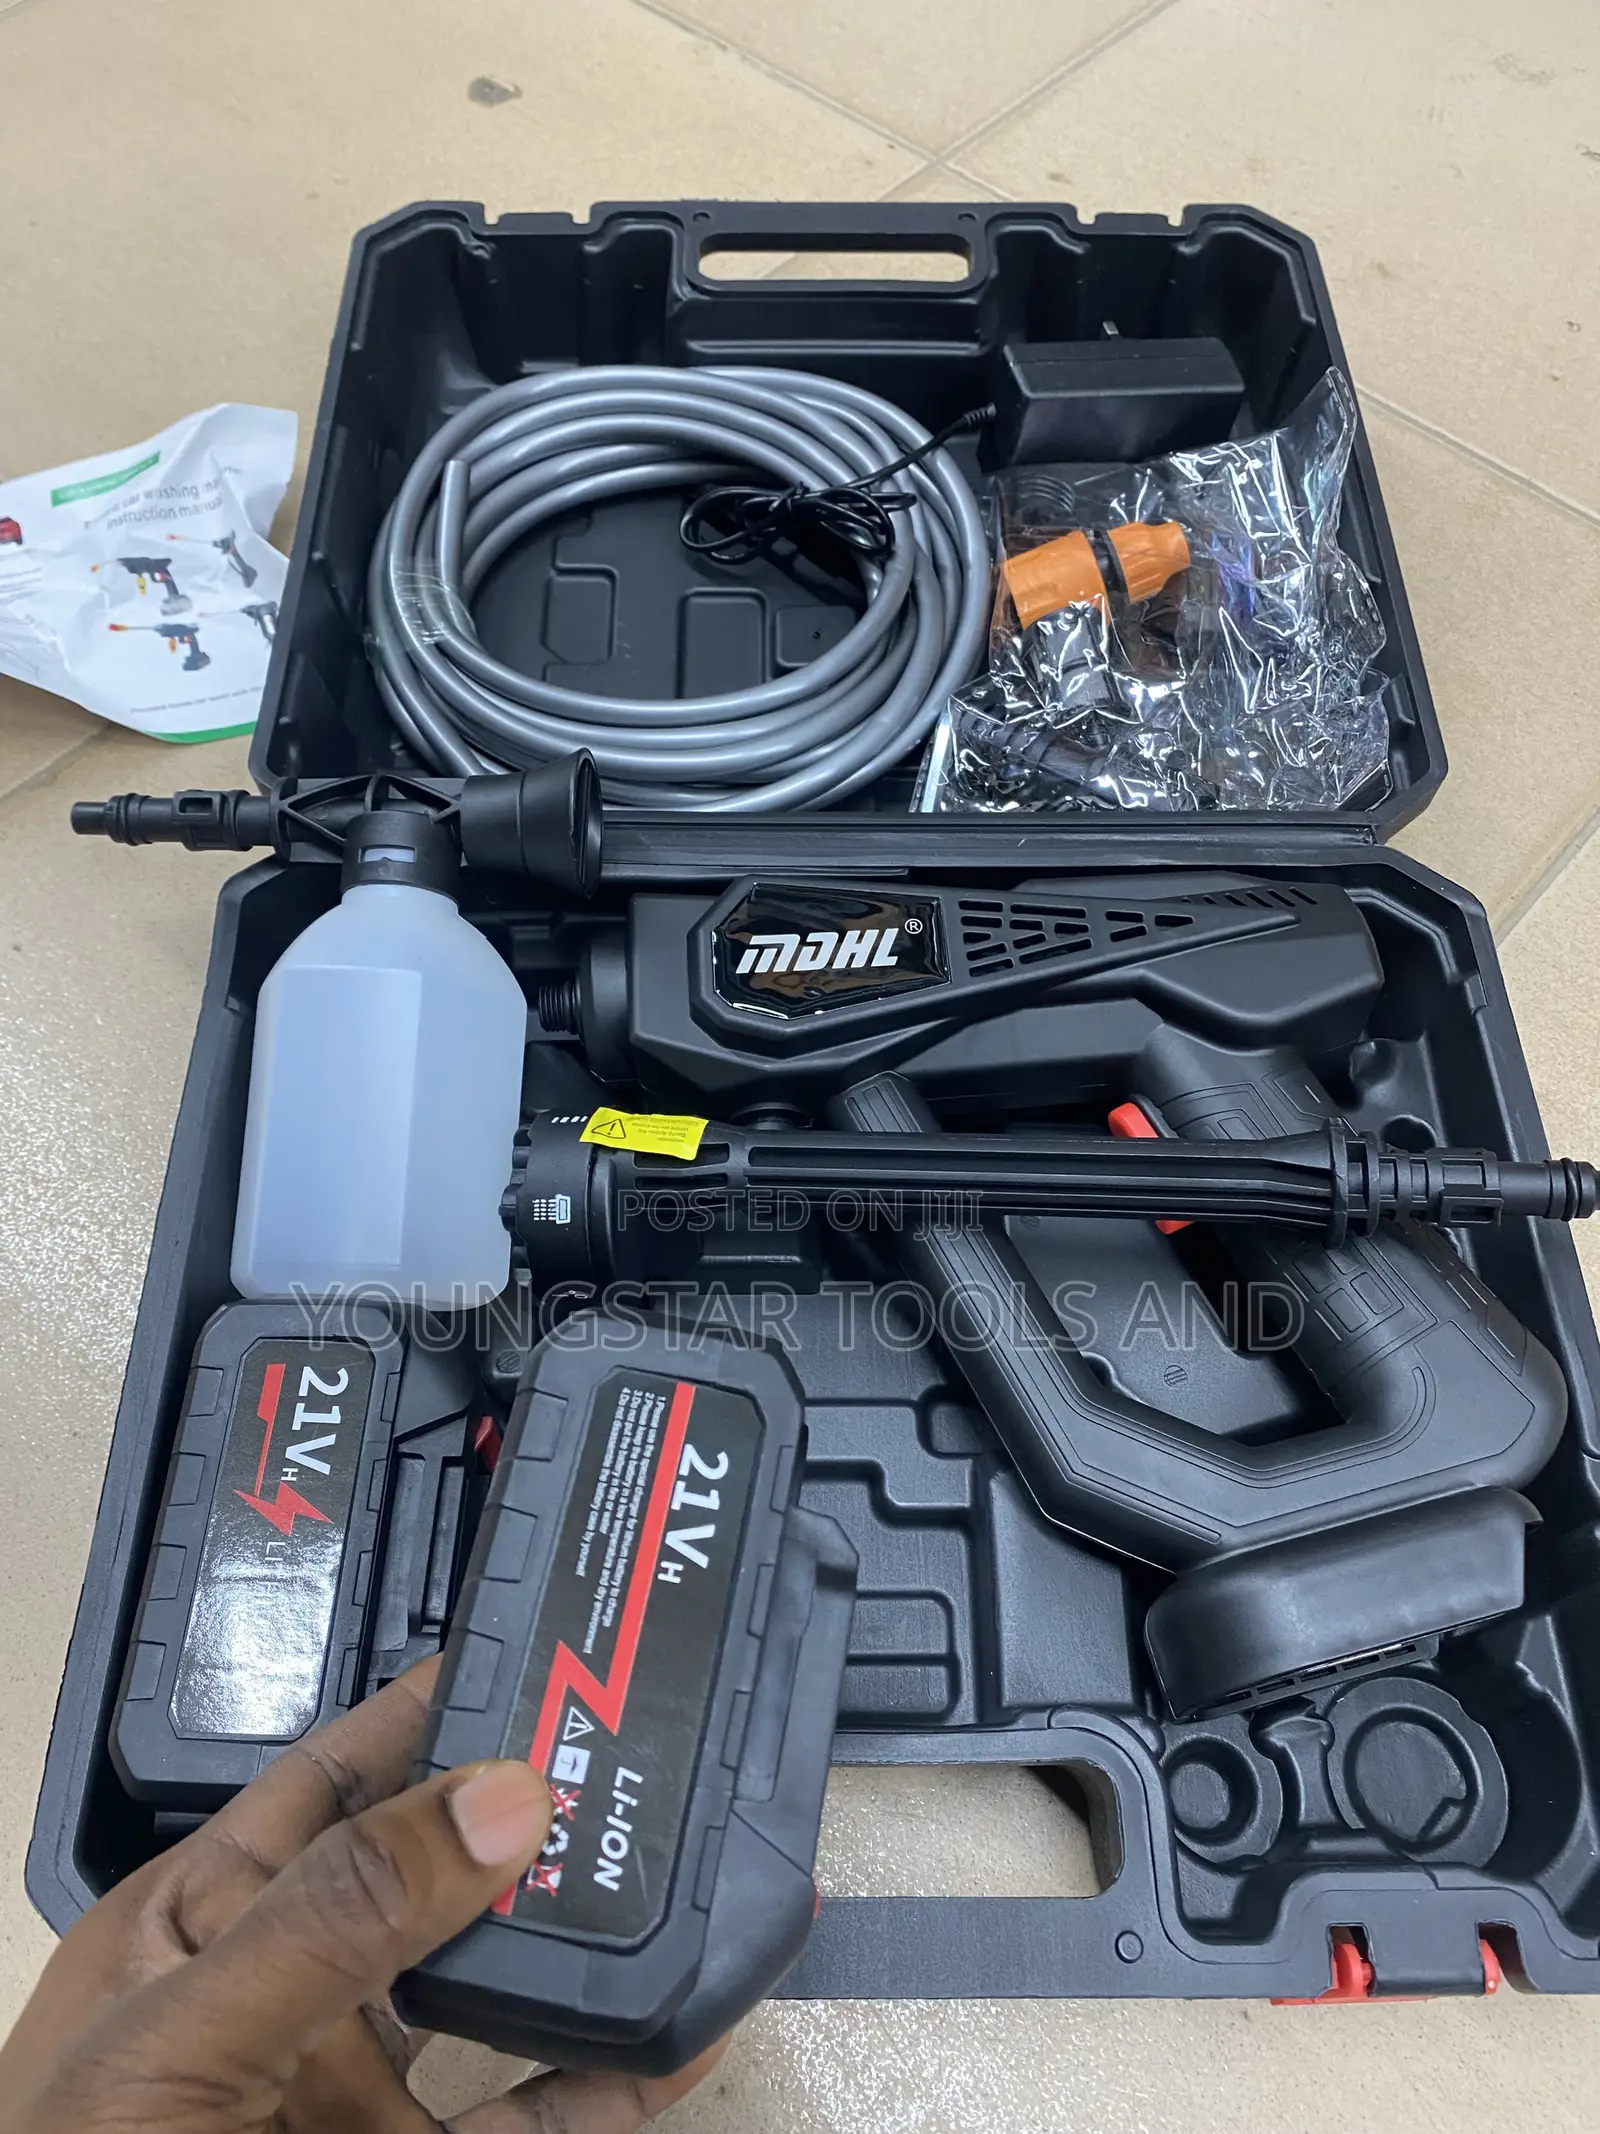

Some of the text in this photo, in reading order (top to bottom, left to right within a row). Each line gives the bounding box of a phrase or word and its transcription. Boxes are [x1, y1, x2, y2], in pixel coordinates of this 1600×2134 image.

[179, 496, 223, 518] manua
[615, 1406, 624, 1419] not
[627, 1409, 636, 1422] not
[624, 1422, 633, 1436] put
[633, 1426, 646, 1445] keep
[620, 1436, 630, 1449] the
[630, 1447, 641, 1459] the
[643, 1445, 654, 1457] the
[612, 1450, 628, 1477] battery
[599, 1469, 610, 1481] the
[622, 1460, 638, 1487] battery
[612, 1478, 619, 1486] in
[590, 1482, 607, 1510] battery
[607, 1487, 619, 1500] fire
[606, 1501, 613, 1510] or
[616, 1505, 627, 1519] low
[587, 1511, 598, 1530] case
[600, 1512, 611, 1534] water
[627, 1518, 637, 1530] for
[582, 1531, 595, 1542] by
[576, 1543, 590, 1577] yourself
[599, 1569, 610, 1586] and
[611, 1558, 627, 1587] battery
[594, 1586, 607, 1601] dry
[610, 1588, 620, 1597] to
[602, 1598, 617, 1627] charge
